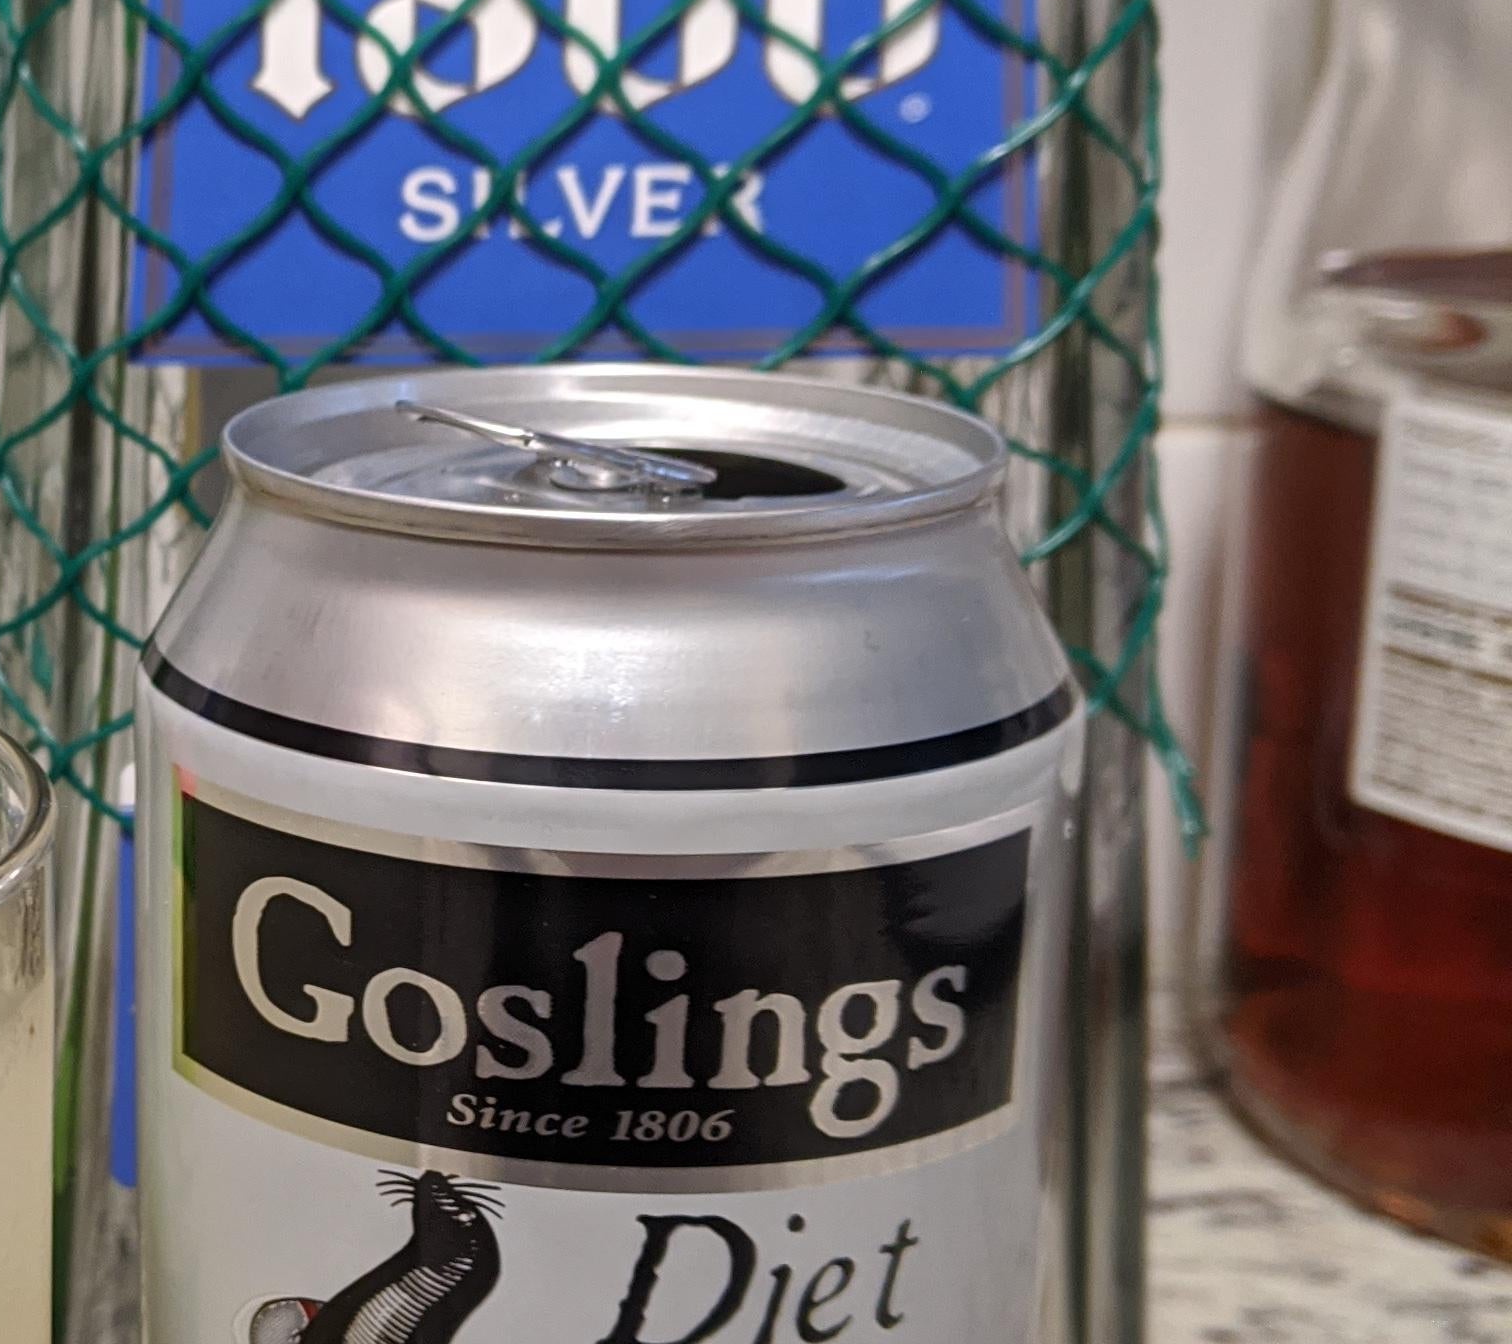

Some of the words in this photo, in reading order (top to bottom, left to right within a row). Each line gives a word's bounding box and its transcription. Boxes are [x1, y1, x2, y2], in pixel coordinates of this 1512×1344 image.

[231, 875, 968, 1139] Goslings
[446, 1093, 588, 1140] Since
[608, 1107, 736, 1144] 1806
